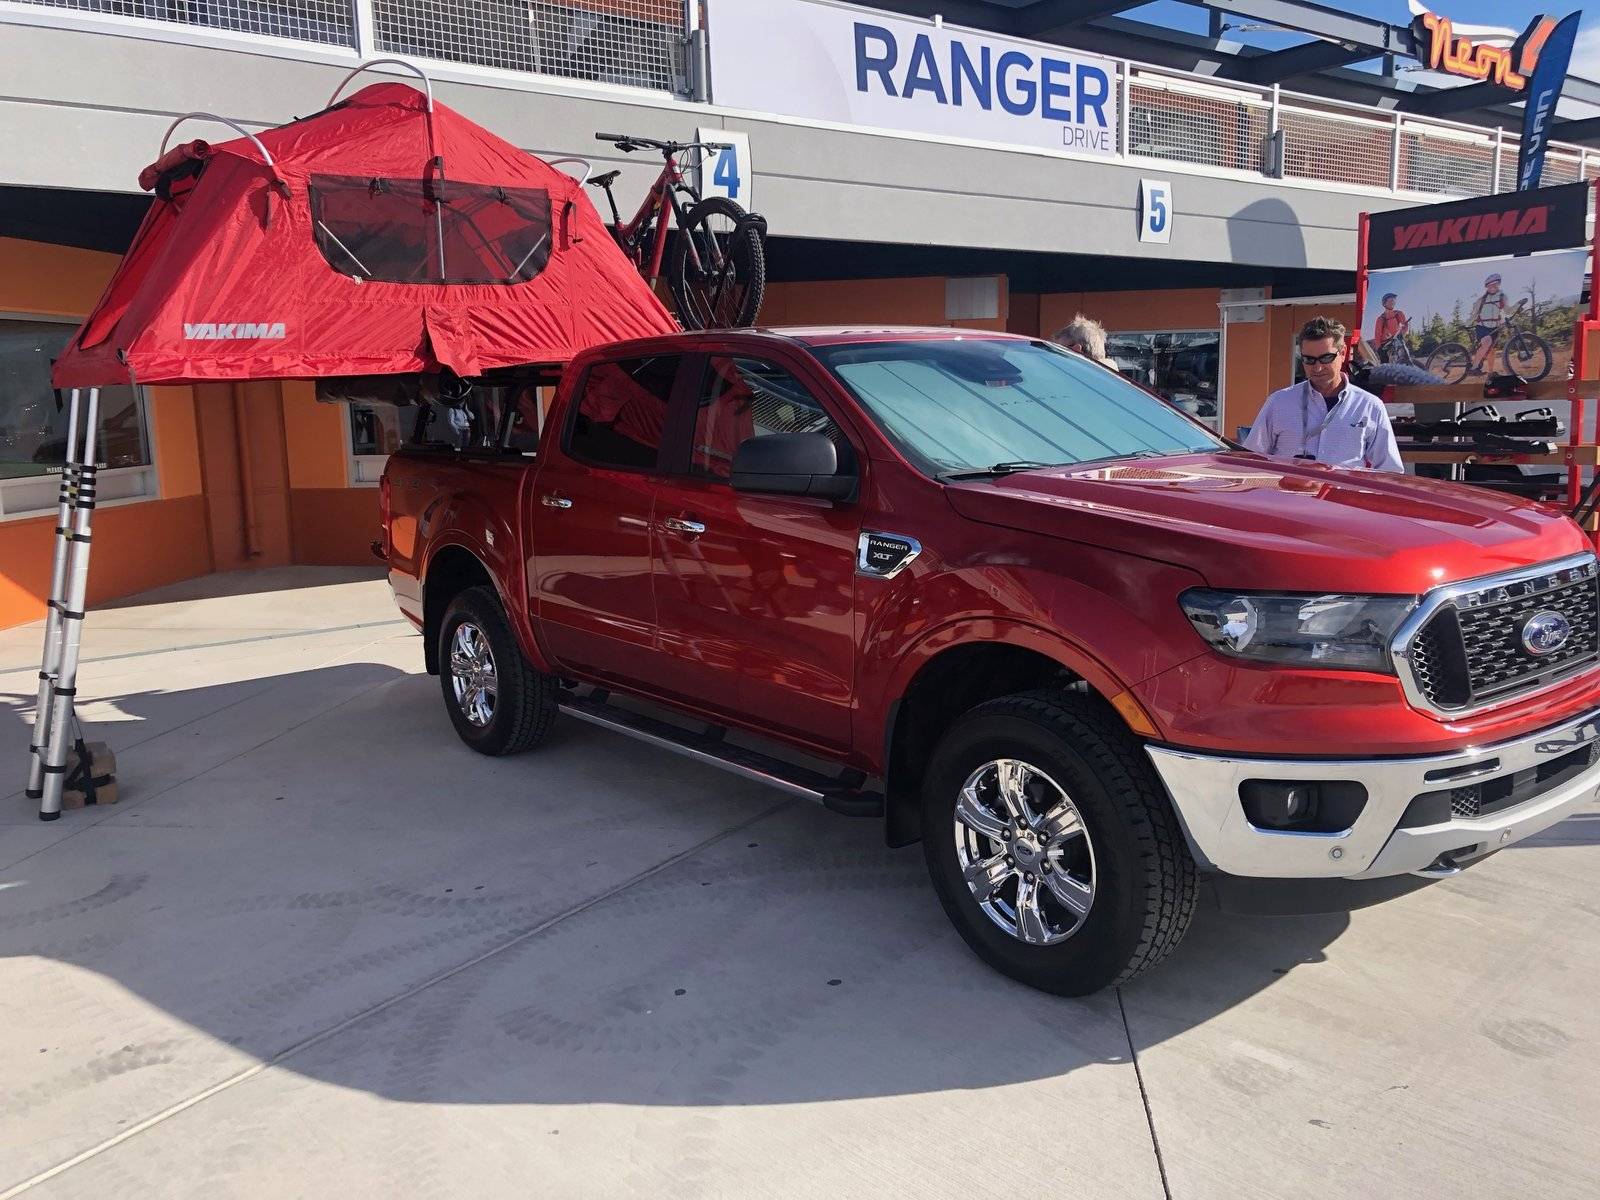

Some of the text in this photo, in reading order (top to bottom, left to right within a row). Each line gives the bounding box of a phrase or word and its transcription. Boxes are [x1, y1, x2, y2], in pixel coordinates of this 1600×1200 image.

[1423, 12, 1527, 91] Neon
[854, 22, 1109, 127] RANGER
[1062, 126, 1109, 151] DRIVE
[713, 144, 740, 199] 4
[1150, 189, 1166, 233] 5
[1393, 206, 1548, 251] YAKIMA
[184, 323, 285, 340] YAKIMA
[870, 540, 908, 551] RANGER
[873, 551, 893, 560] XLT
